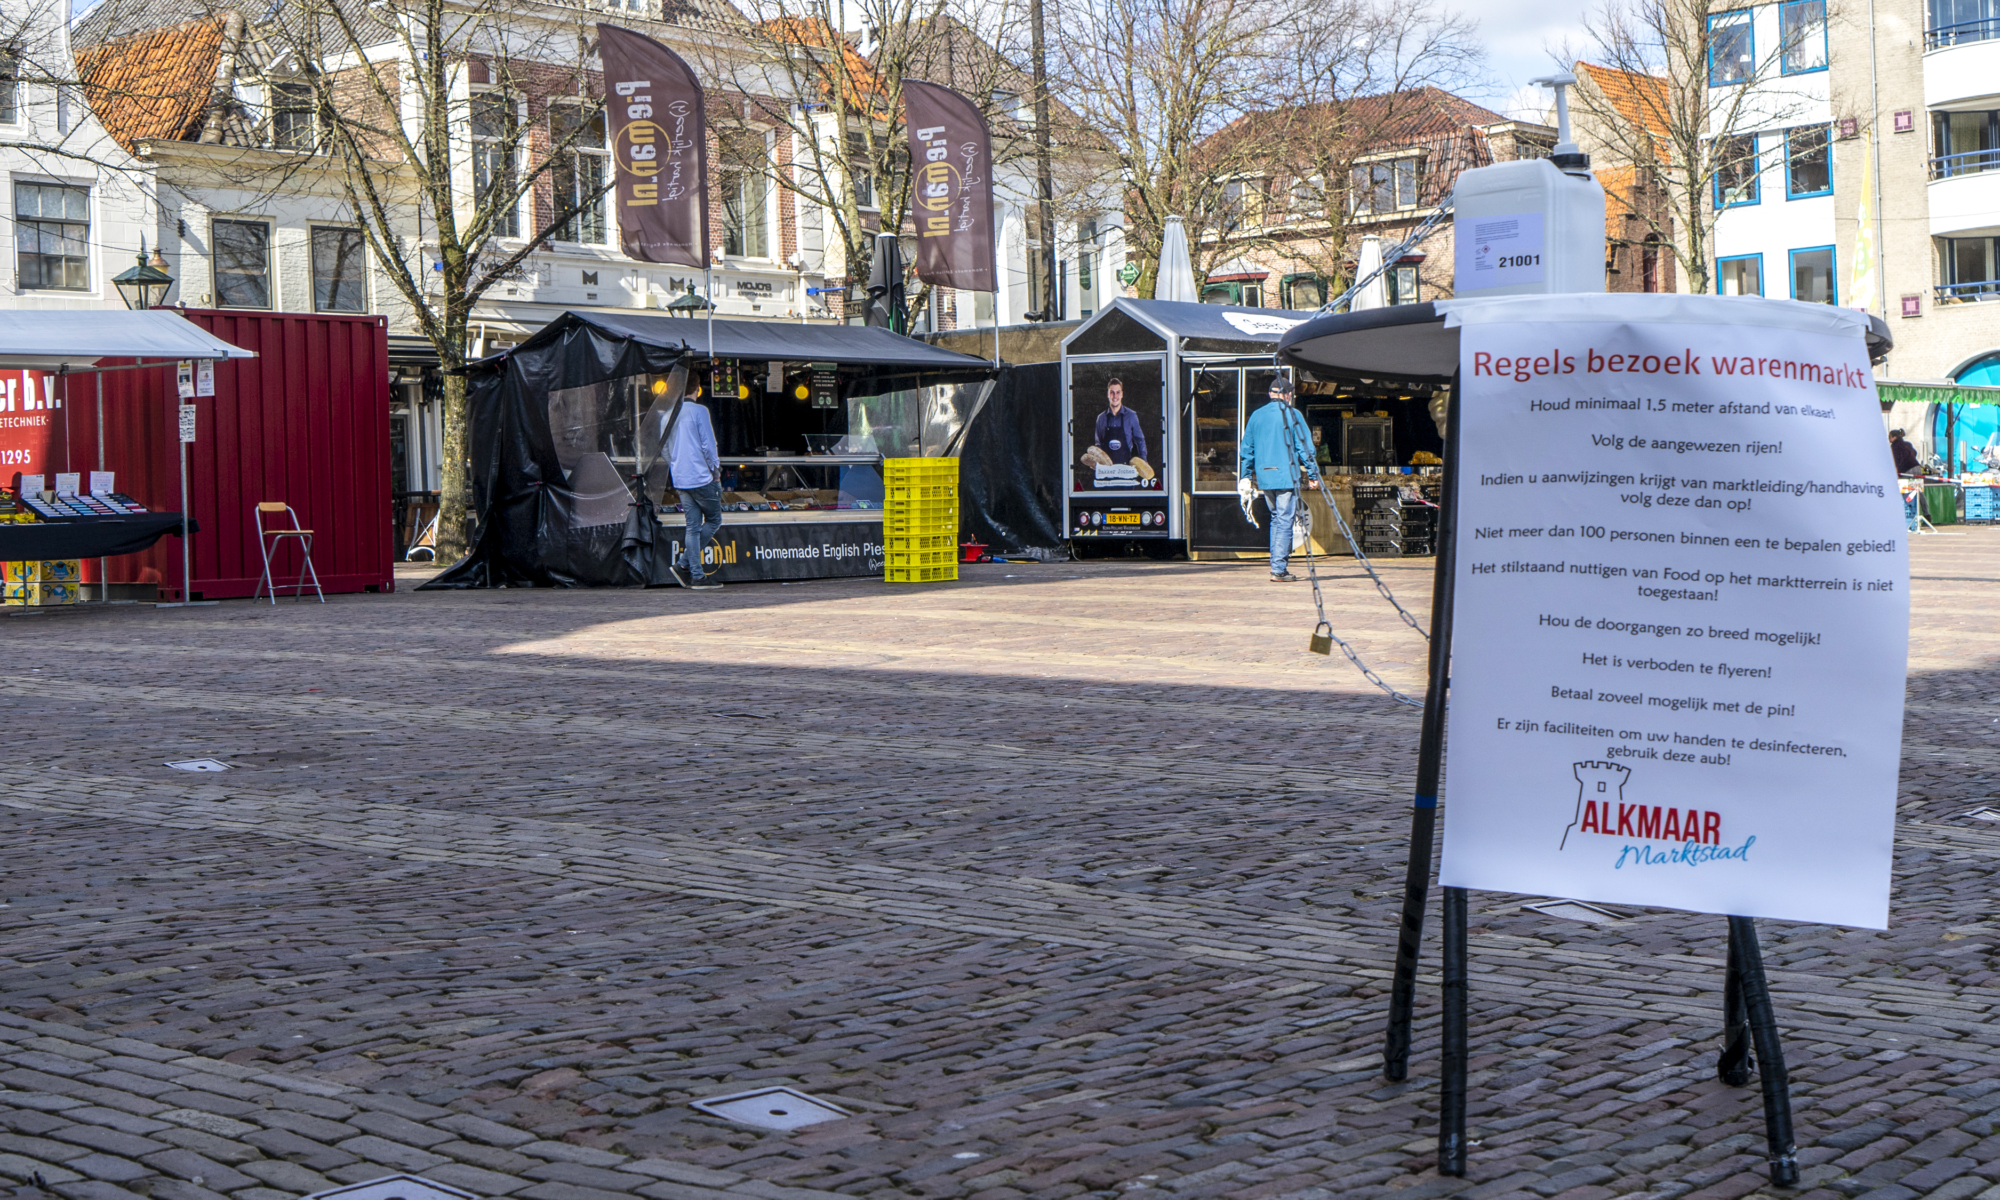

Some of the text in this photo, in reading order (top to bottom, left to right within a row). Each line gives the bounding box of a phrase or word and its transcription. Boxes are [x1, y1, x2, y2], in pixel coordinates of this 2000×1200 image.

[1499, 254, 1540, 268] 21001
[737, 281, 772, 291] MOJO'S
[1474, 347, 1868, 390] Regels bezoek warenmarkt
[23, 369, 61, 411] b.v.
[1530, 397, 1571, 412] Houd
[1575, 396, 1641, 410] minimaal
[1671, 401, 1715, 414] meter
[1718, 400, 1771, 415] afstand
[1774, 405, 1798, 417] van
[1800, 405, 1836, 420] elkaar!
[1, 449, 31, 465] 1295
[1591, 433, 1783, 456] Volg de aangewezen rijen!
[1481, 470, 1885, 499] Indien u aanwijzingen krijgt van marktleiding/handhaving
[1620, 491, 1752, 513] volg deze dan op!
[671, 540, 737, 566] Pian.nl
[755, 545, 820, 560] Homemade
[823, 543, 860, 561] English
[1475, 524, 1896, 556] Niet meer dan 100 personen binnen een te bepalen gebied!
[1471, 560, 1894, 592] Het stilstaand nuttigen van Food op het marktterrein is niet
[1638, 584, 1719, 602] toegestaan!
[1539, 613, 1821, 647] Hou de doorgangen zo breed mogelijk!
[1582, 652, 1772, 679] Het is verboden te flyeren!
[1551, 685, 1796, 718] Betaal zoveel mogelijk met de pin!
[1497, 717, 1511, 730] Er
[1515, 719, 1539, 734] zijn
[1543, 720, 1614, 738] faciliteiten
[1618, 730, 1643, 741] om
[1647, 732, 1670, 743] uw
[1673, 731, 1726, 748] handen
[1731, 737, 1745, 749] te
[1606, 745, 1731, 766] gebruik deze aub!
[1580, 799, 1722, 846] ALKMAAR
[1614, 834, 1757, 870] Marktstad
